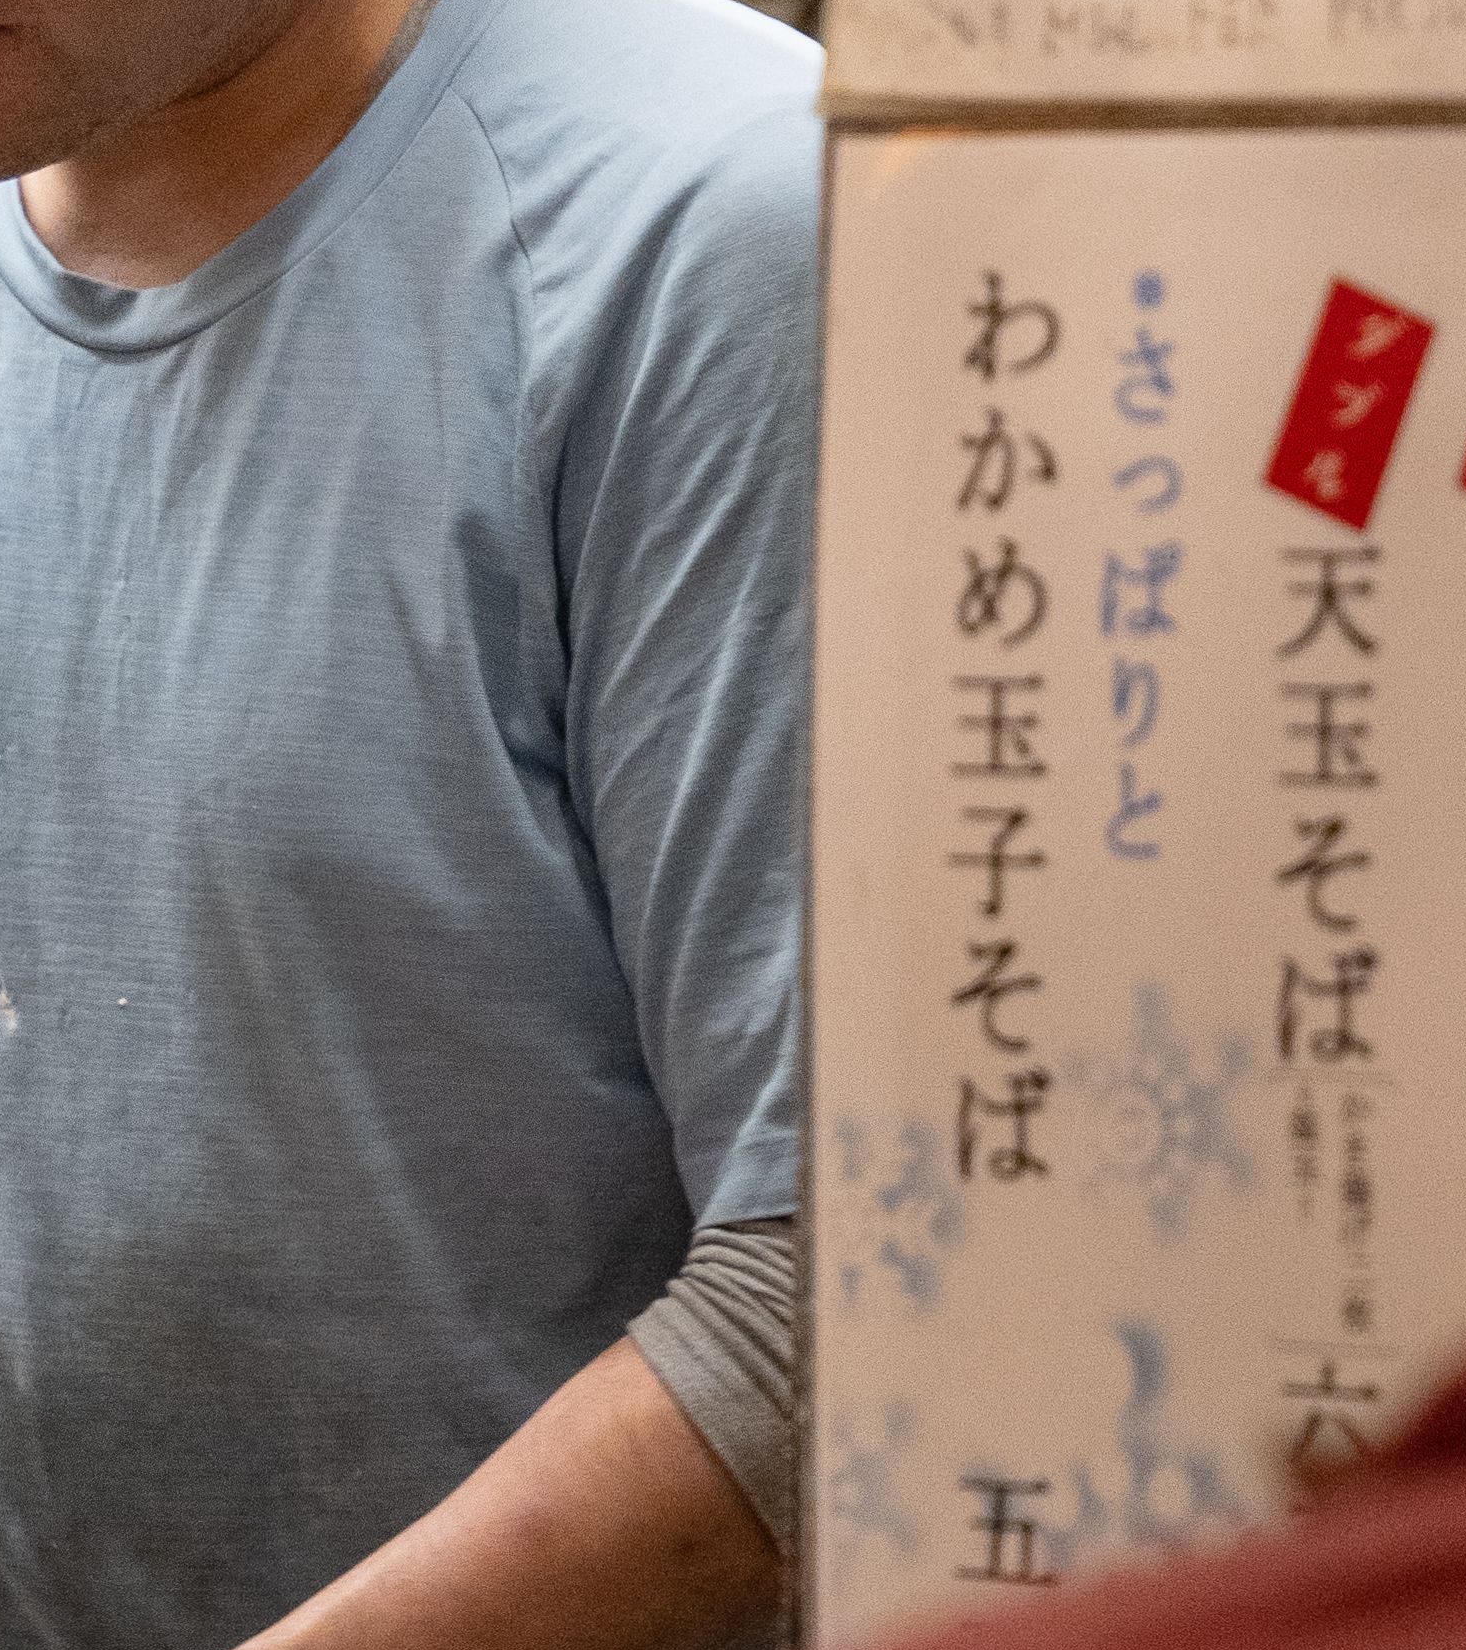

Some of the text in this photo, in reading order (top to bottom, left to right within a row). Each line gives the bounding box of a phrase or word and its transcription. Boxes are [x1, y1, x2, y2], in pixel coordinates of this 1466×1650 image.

[946, 269, 1061, 1182] わかめ玉子そば
[1276, 545, 1384, 1063] 天玉そば
